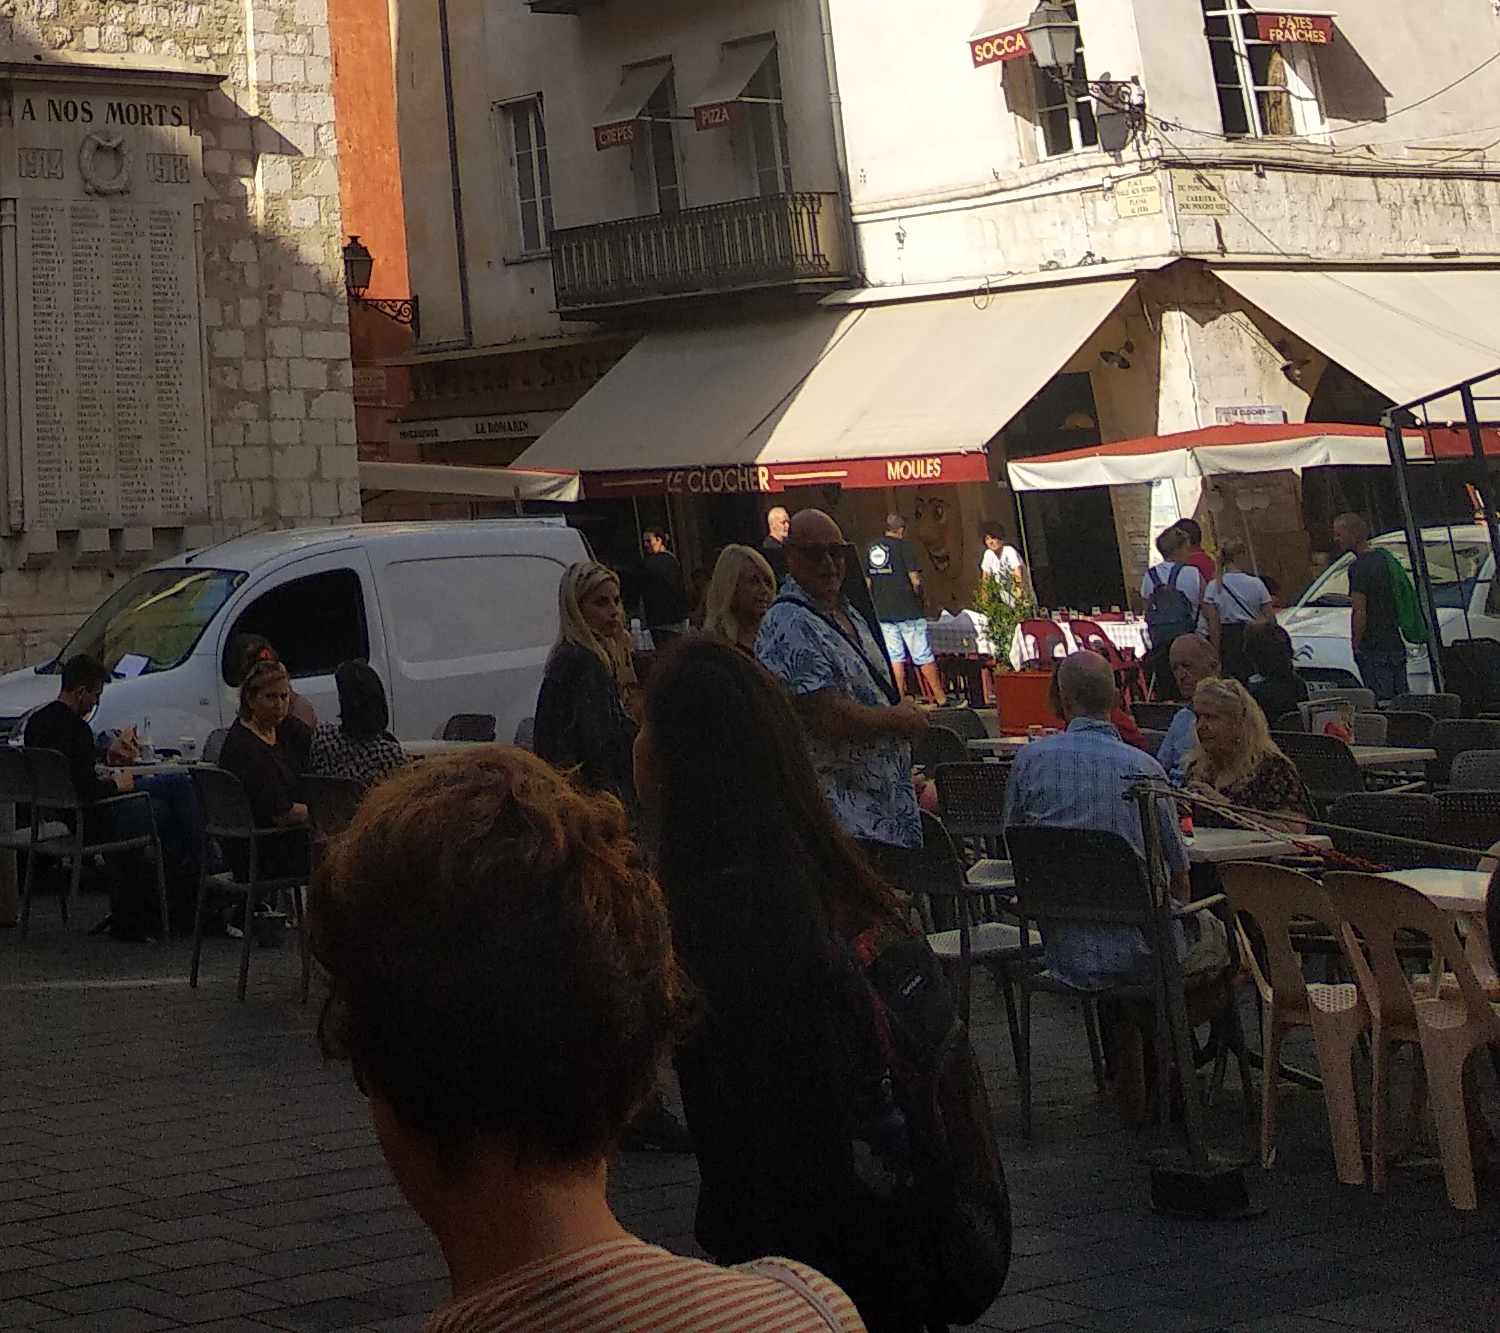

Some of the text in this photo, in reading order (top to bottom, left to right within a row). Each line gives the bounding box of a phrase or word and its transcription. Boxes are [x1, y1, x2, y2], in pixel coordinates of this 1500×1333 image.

[974, 32, 1027, 62] SOCCA
[21, 98, 183, 127] A NOS MORTS
[700, 107, 731, 126] PIZZA
[18, 148, 191, 183] 1914 1918
[665, 465, 772, 493] LE CLOCHER
[886, 457, 943, 481] MOULES
